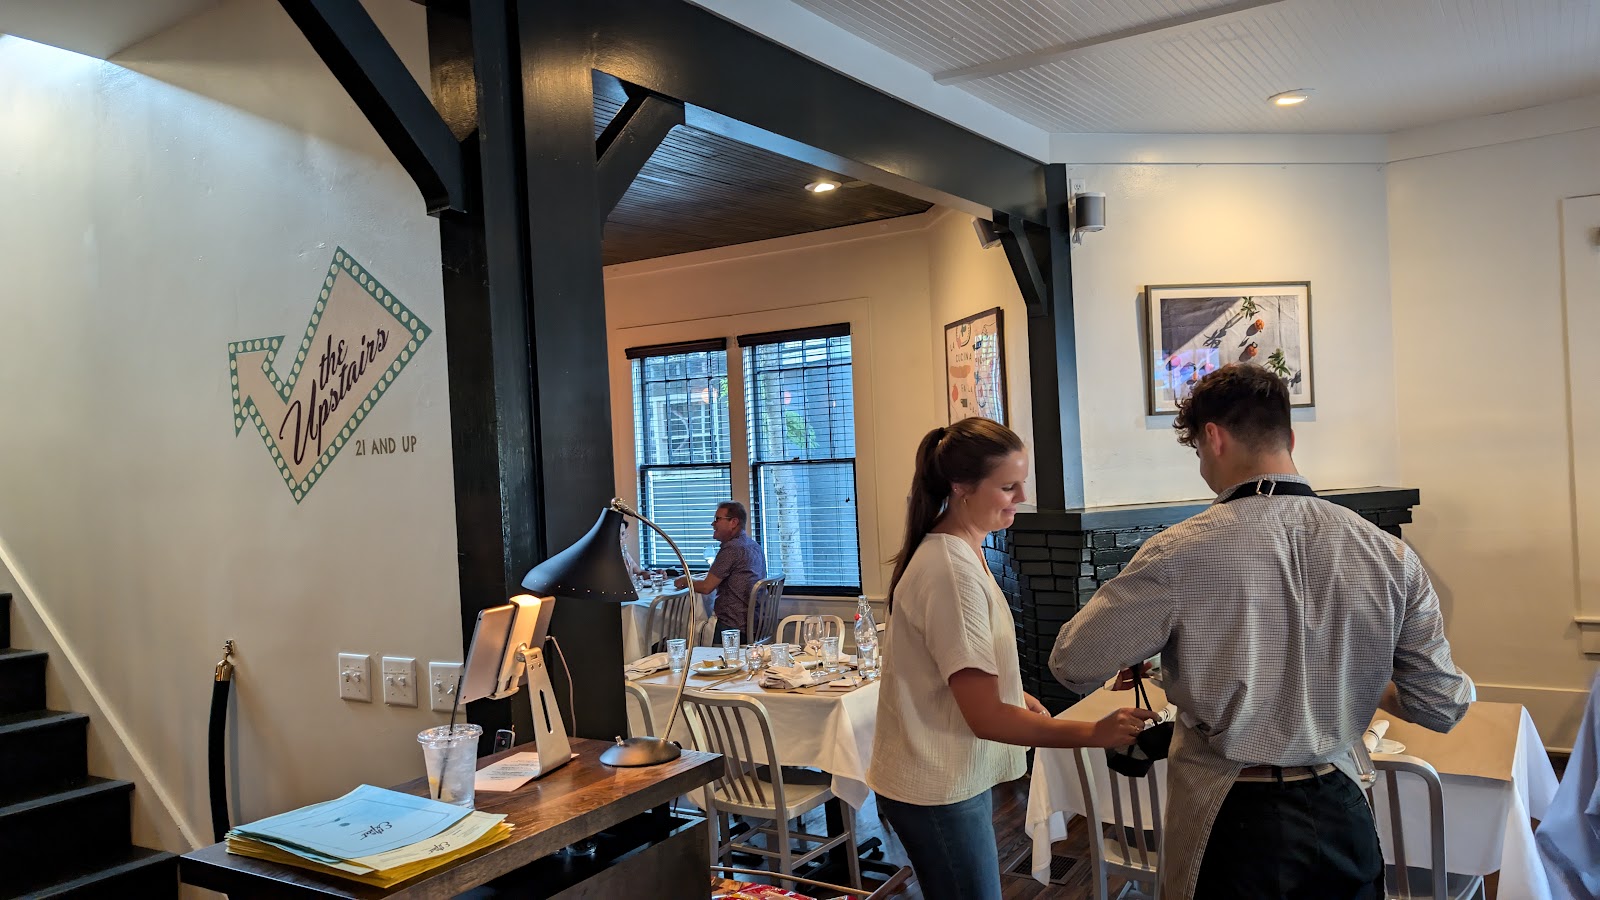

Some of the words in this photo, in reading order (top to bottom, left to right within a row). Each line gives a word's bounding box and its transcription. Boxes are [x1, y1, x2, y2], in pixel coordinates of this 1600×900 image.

[319, 334, 348, 390] the
[955, 353, 972, 362] CUCINA
[279, 328, 389, 465] Upstairs
[355, 439, 366, 456] 21
[371, 437, 396, 455] AND
[402, 435, 417, 452] UP
